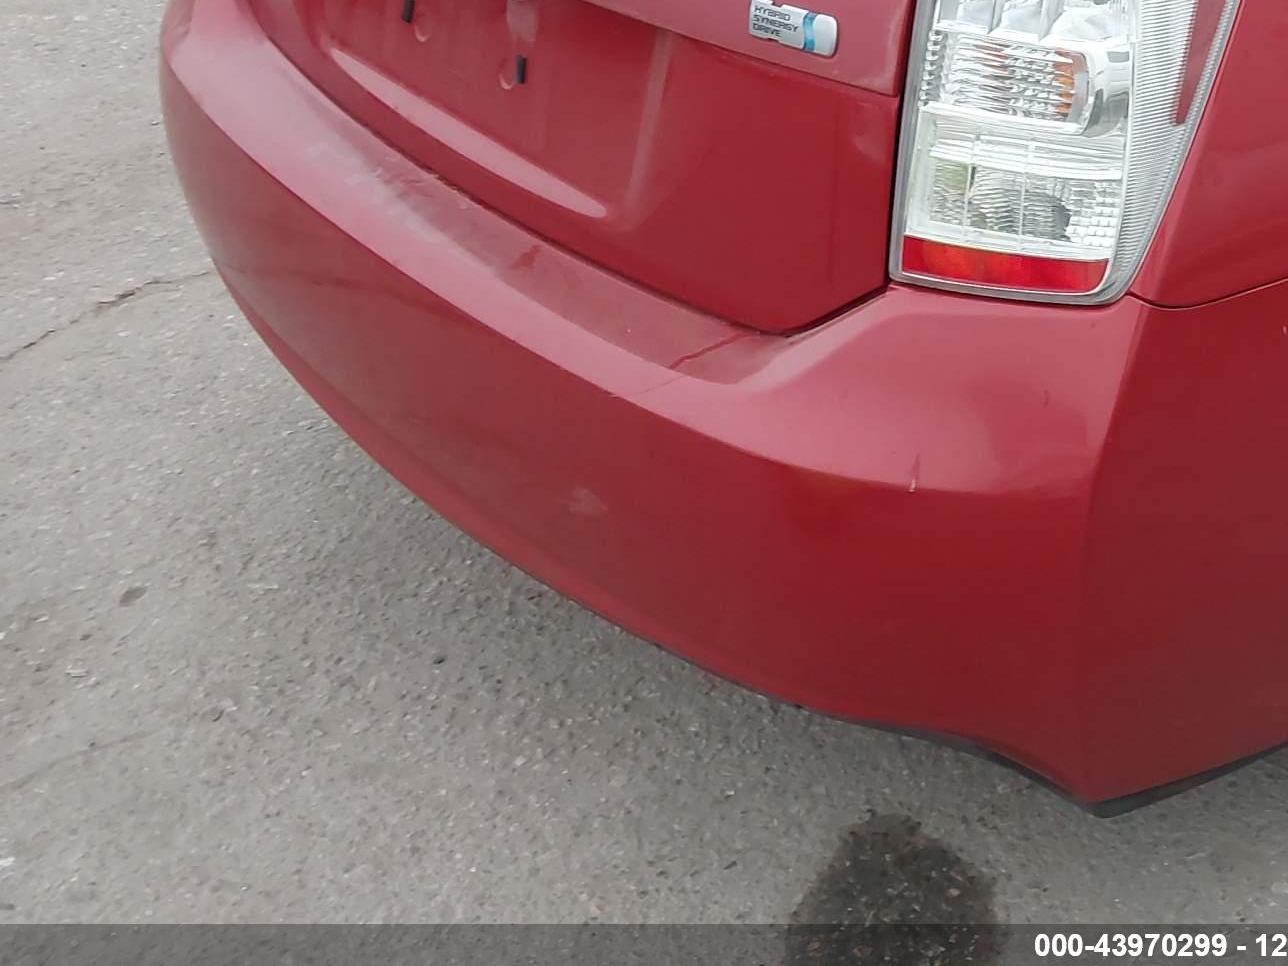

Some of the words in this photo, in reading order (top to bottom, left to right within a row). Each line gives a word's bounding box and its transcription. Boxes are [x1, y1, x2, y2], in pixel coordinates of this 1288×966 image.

[753, 5, 791, 21] HYBRID
[752, 23, 782, 38] DRIVE
[753, 14, 799, 33] SYNERGY
